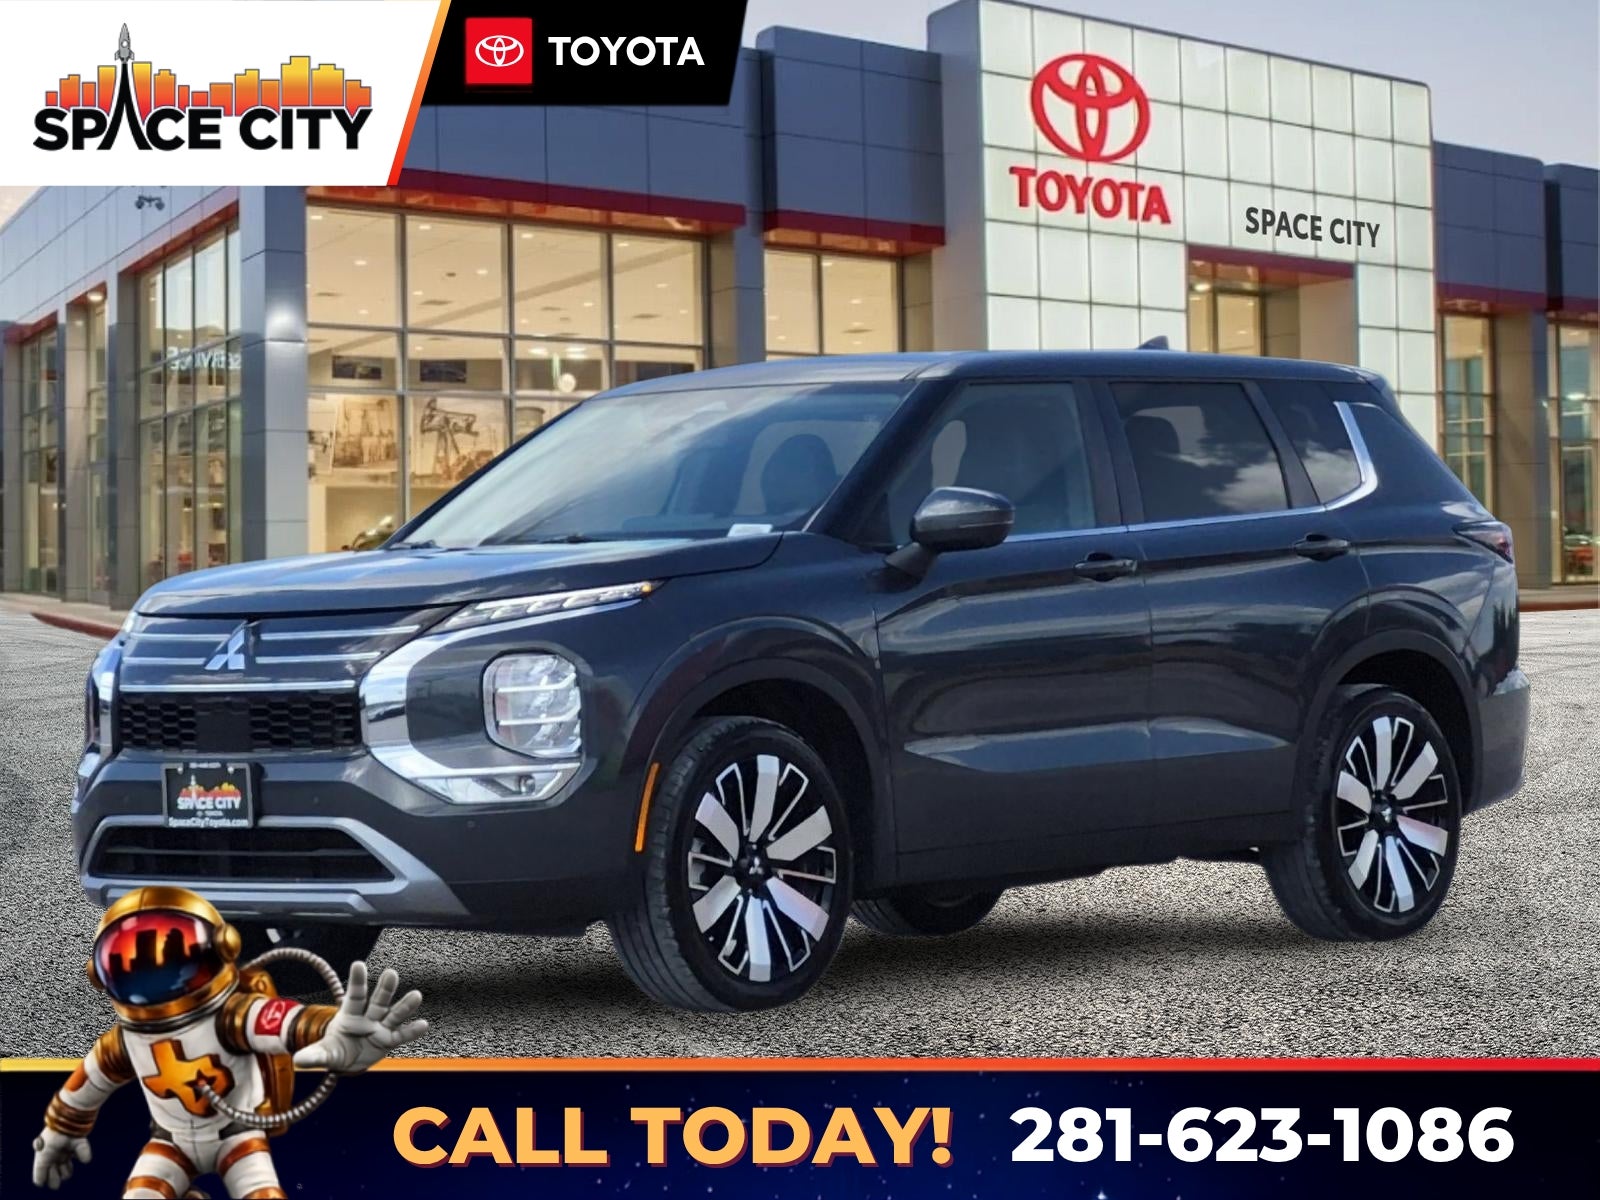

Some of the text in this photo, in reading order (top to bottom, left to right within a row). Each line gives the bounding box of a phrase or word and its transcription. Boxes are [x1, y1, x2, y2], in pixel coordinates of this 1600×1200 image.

[1009, 166, 1171, 225] TOYOTA
[1245, 206, 1381, 248] SPACE CITY
[177, 796, 241, 810] SPACE CITY
